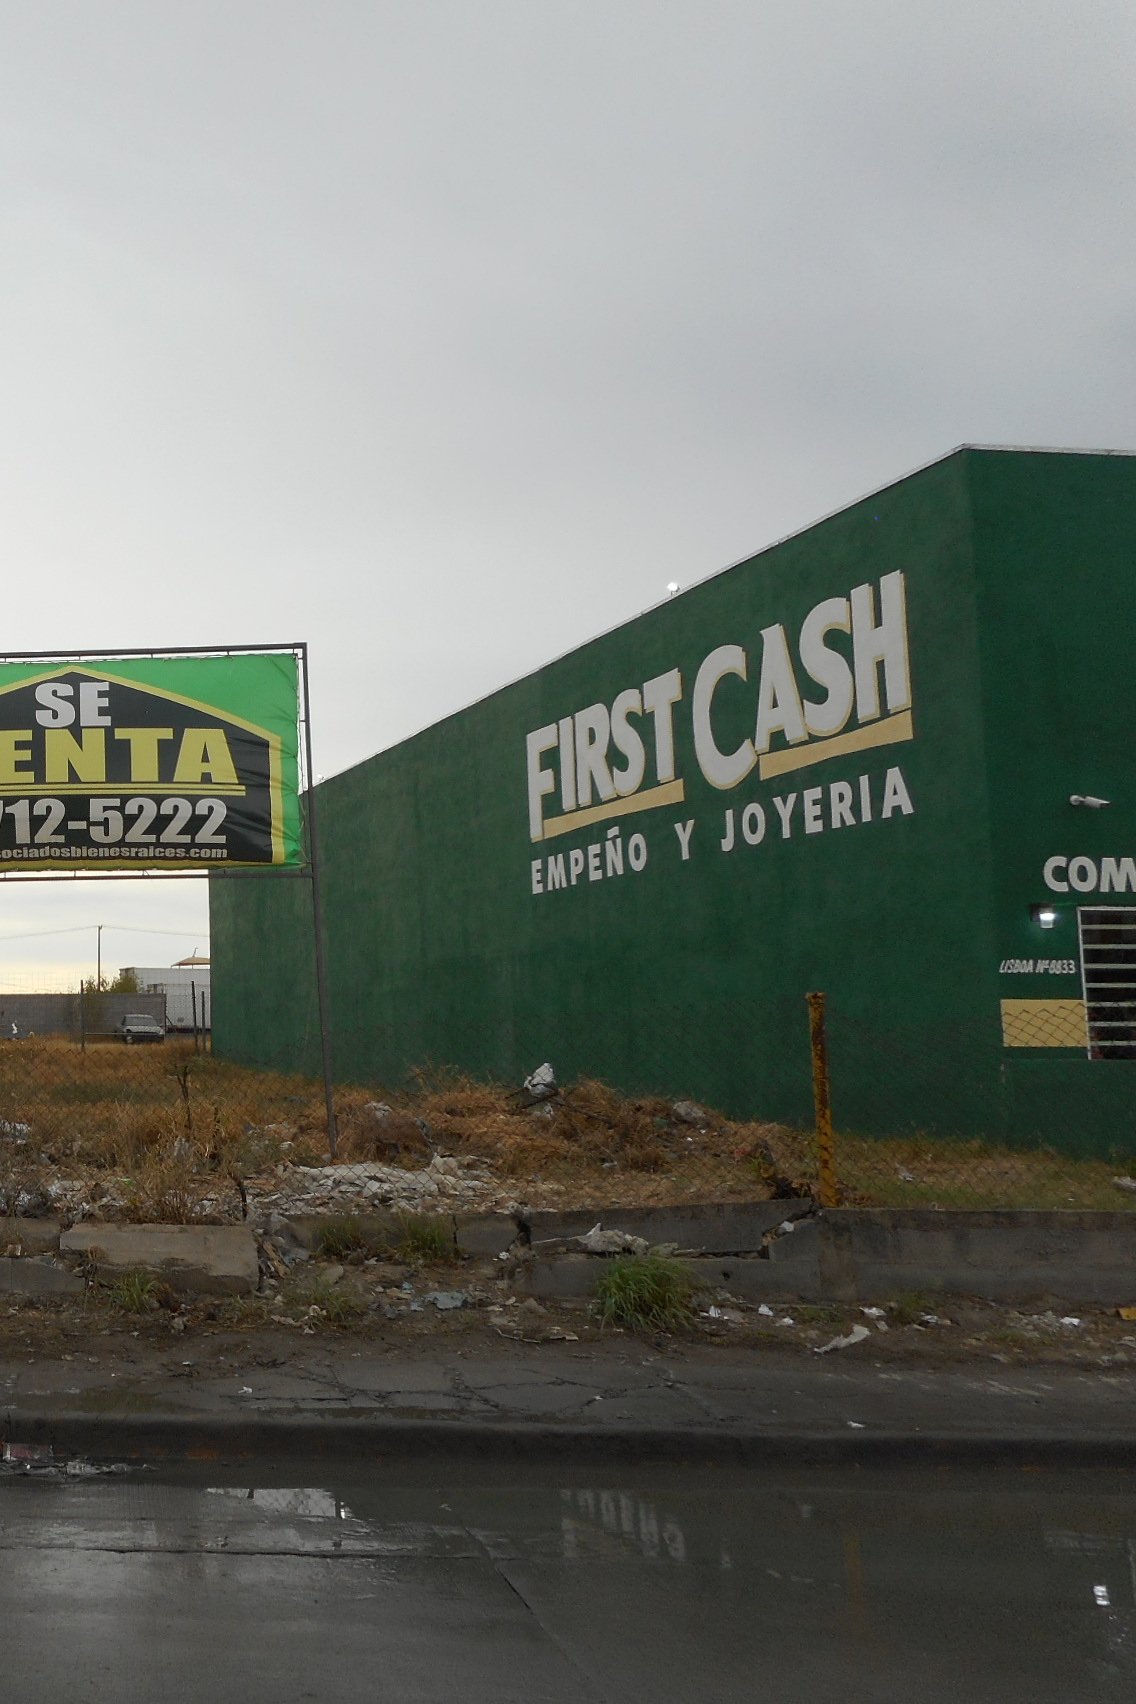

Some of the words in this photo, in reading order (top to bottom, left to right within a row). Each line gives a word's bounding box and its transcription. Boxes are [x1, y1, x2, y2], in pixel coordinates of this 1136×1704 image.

[34, 681, 111, 728] SE
[526, 668, 682, 843] FIRST
[692, 569, 912, 790] CASH
[531, 826, 647, 894] EMPEÑO
[674, 819, 695, 861] Y
[721, 766, 914, 852] JOYERIA
